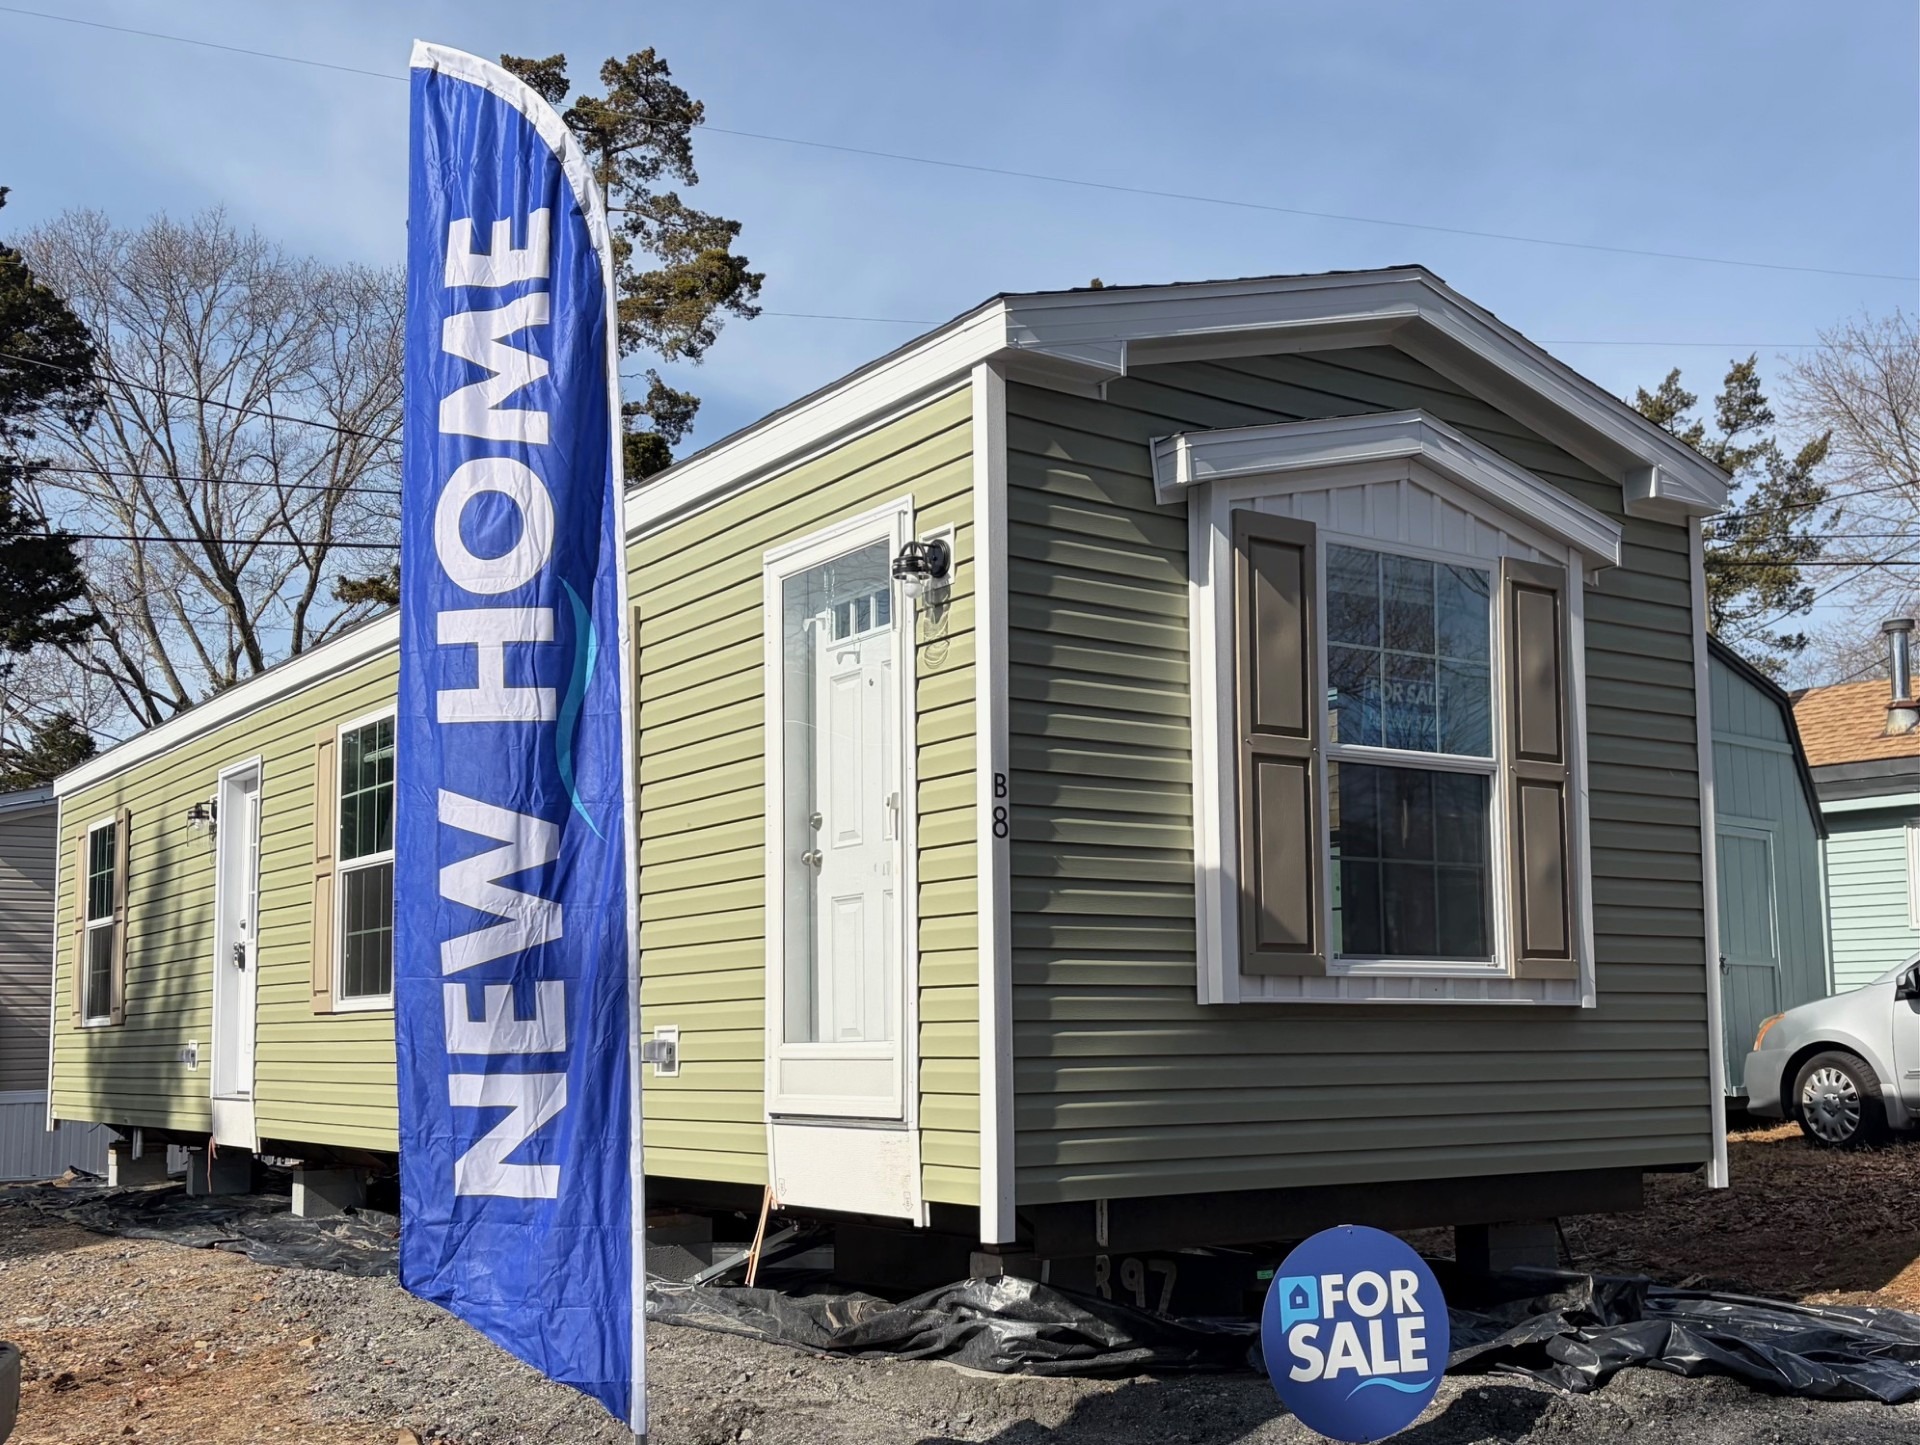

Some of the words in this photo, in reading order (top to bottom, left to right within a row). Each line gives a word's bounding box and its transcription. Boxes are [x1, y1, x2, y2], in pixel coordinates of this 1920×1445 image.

[435, 207, 556, 724] HOME
[1406, 684, 1444, 706] SALE
[438, 788, 567, 1199] NEW
[1320, 1270, 1424, 1319] FOR
[1288, 1316, 1429, 1382] SALE
